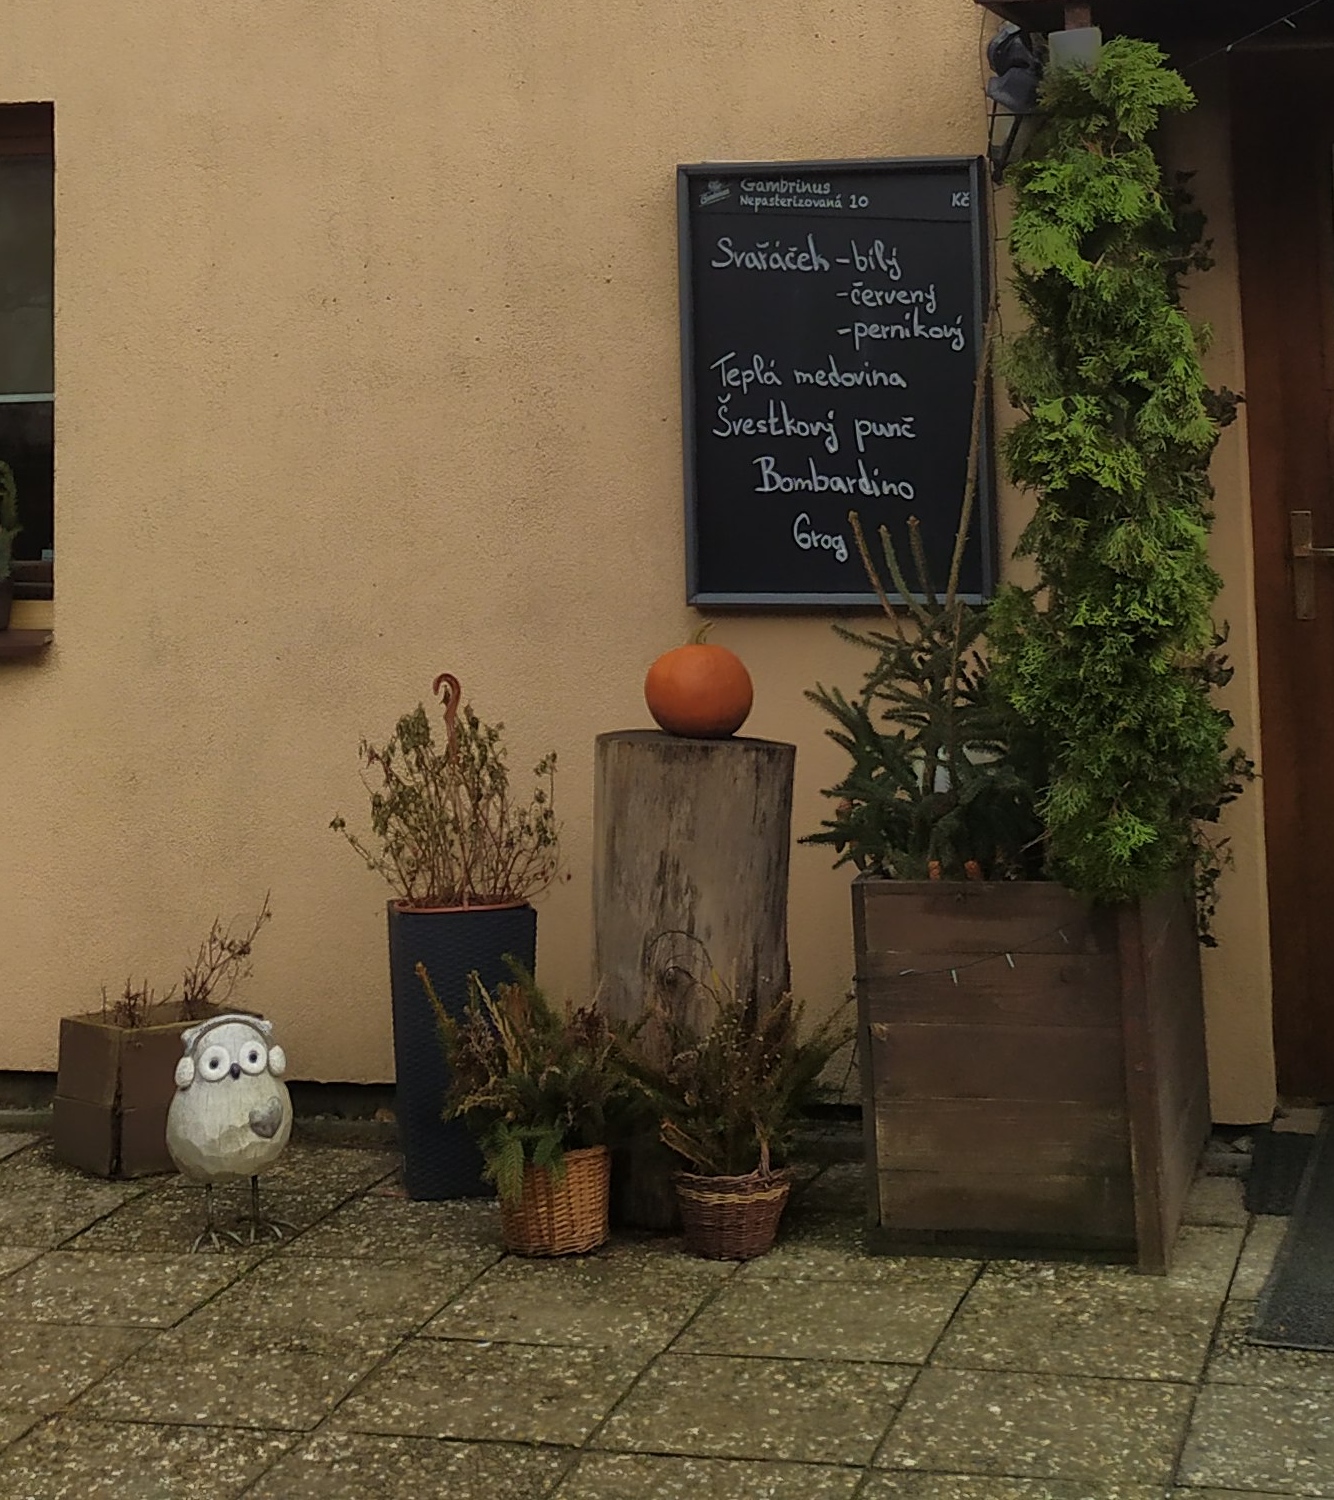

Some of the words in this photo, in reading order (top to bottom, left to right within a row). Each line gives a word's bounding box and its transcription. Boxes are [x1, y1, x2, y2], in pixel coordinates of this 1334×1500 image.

[739, 176, 831, 194] Gambrinus
[739, 193, 843, 212] Nepasterizovaná
[848, 194, 869, 208] 10
[951, 192, 970, 207] Kč
[710, 351, 782, 394] Teplá
[793, 354, 907, 388] medovina
[712, 393, 839, 454] Švestkový
[854, 416, 916, 452] punč
[752, 456, 915, 500] Bombardino
[793, 513, 849, 562] Grog
